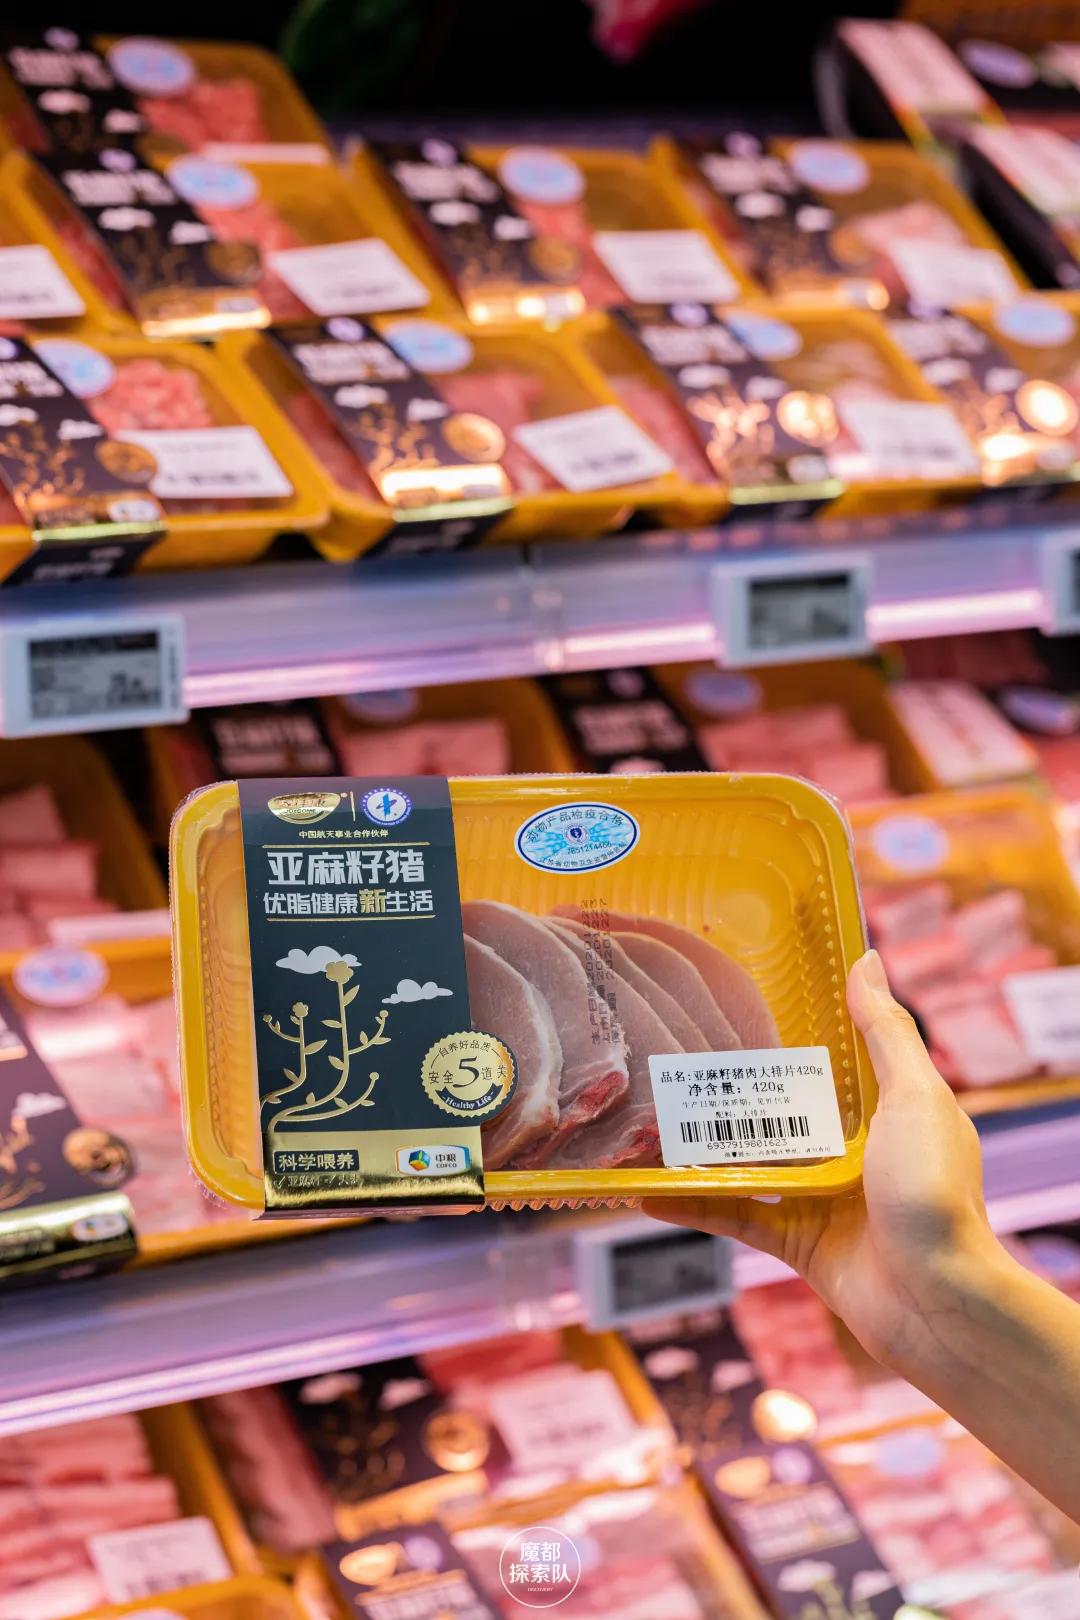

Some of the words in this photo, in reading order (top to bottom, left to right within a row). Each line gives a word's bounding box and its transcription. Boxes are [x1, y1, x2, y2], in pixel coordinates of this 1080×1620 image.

[299, 829, 389, 839] 中国航天事业合作伙伴
[267, 849, 425, 886] 亚麻籽猪
[263, 888, 434, 915] 优脂健康新生活
[438, 1040, 491, 1058] 自养好品质
[445, 1097, 475, 1110] Healthy
[476, 1095, 492, 1108] Life
[706, 1139, 788, 1151] 6937919801623
[278, 1153, 355, 1171] 科学喂养
[435, 1152, 457, 1163] 中粮
